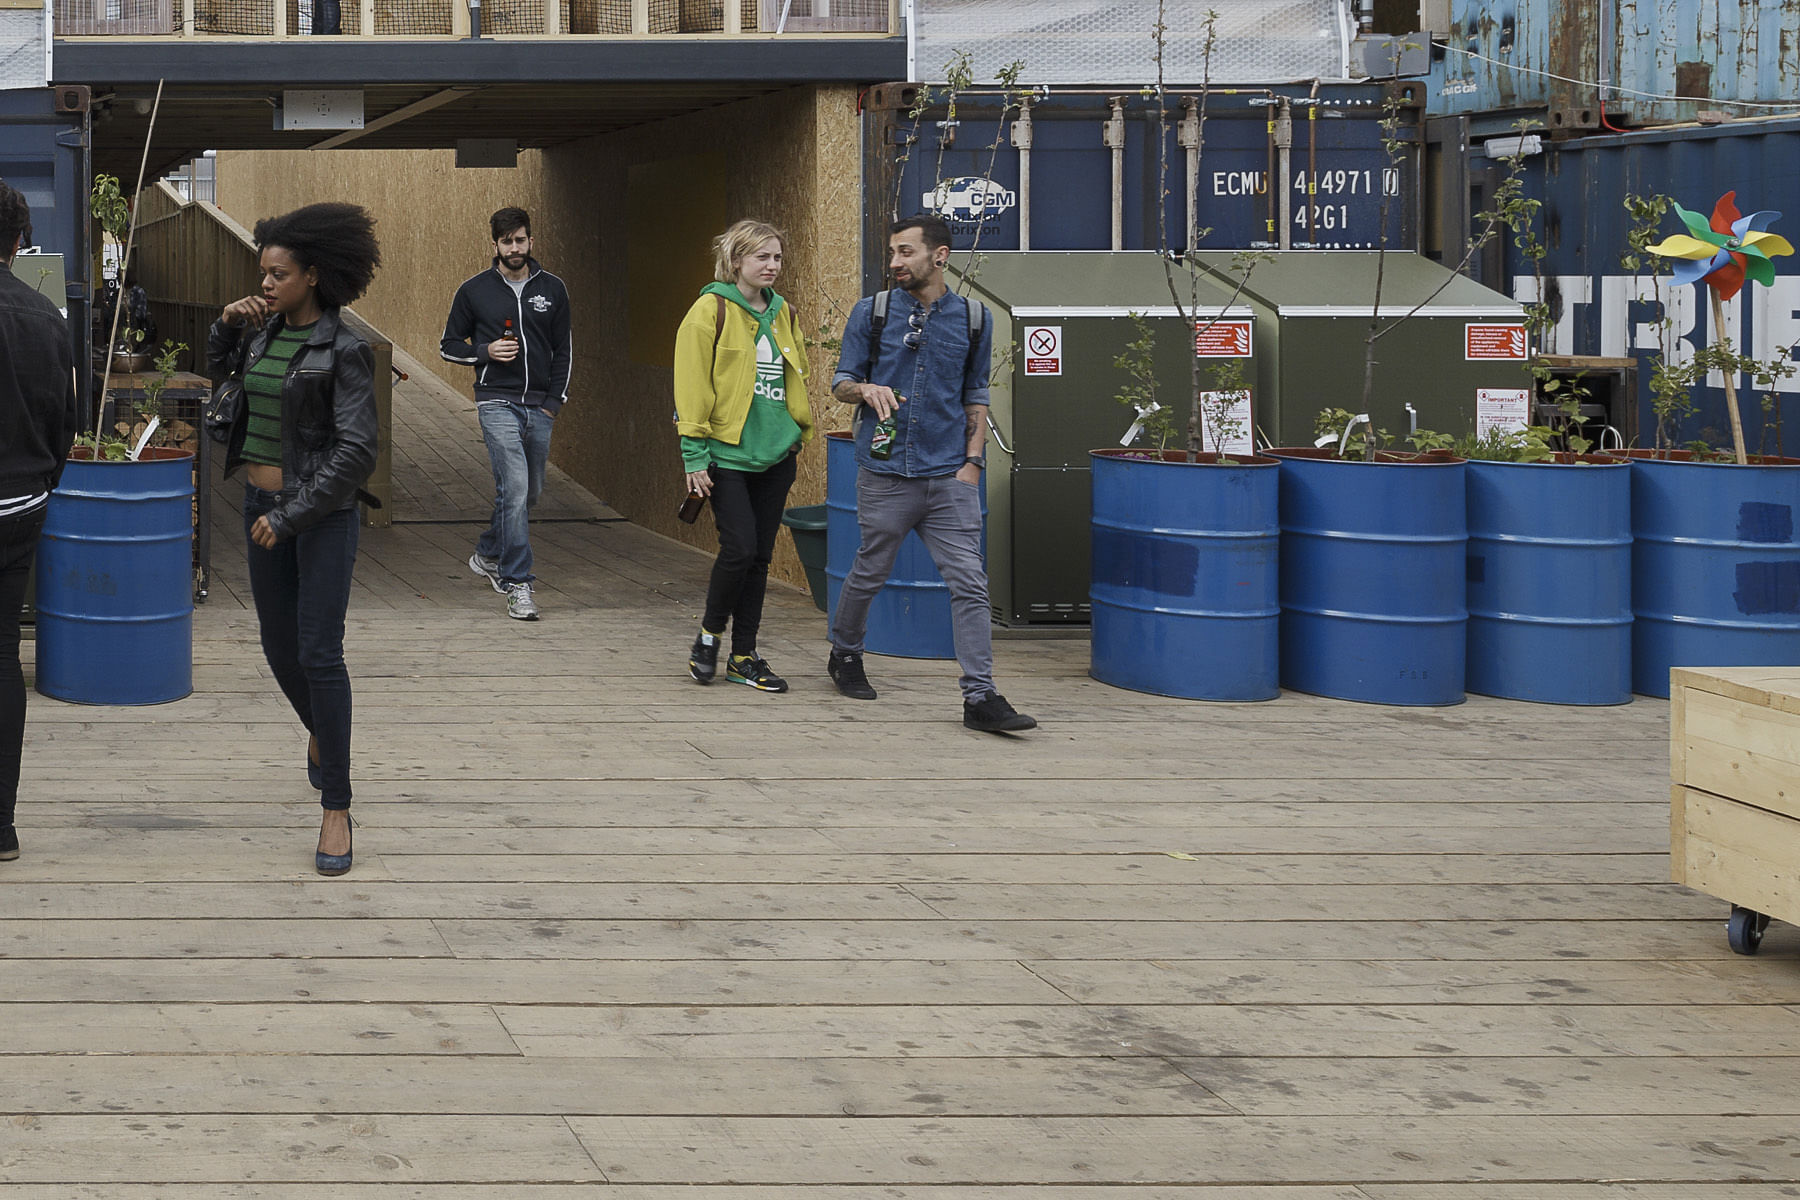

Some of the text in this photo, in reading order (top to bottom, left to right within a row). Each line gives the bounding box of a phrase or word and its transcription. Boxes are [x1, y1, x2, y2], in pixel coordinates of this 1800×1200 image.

[1213, 171, 1268, 196] ECMU
[971, 193, 1013, 206] CGM
[1295, 205, 1347, 229] 42G1
